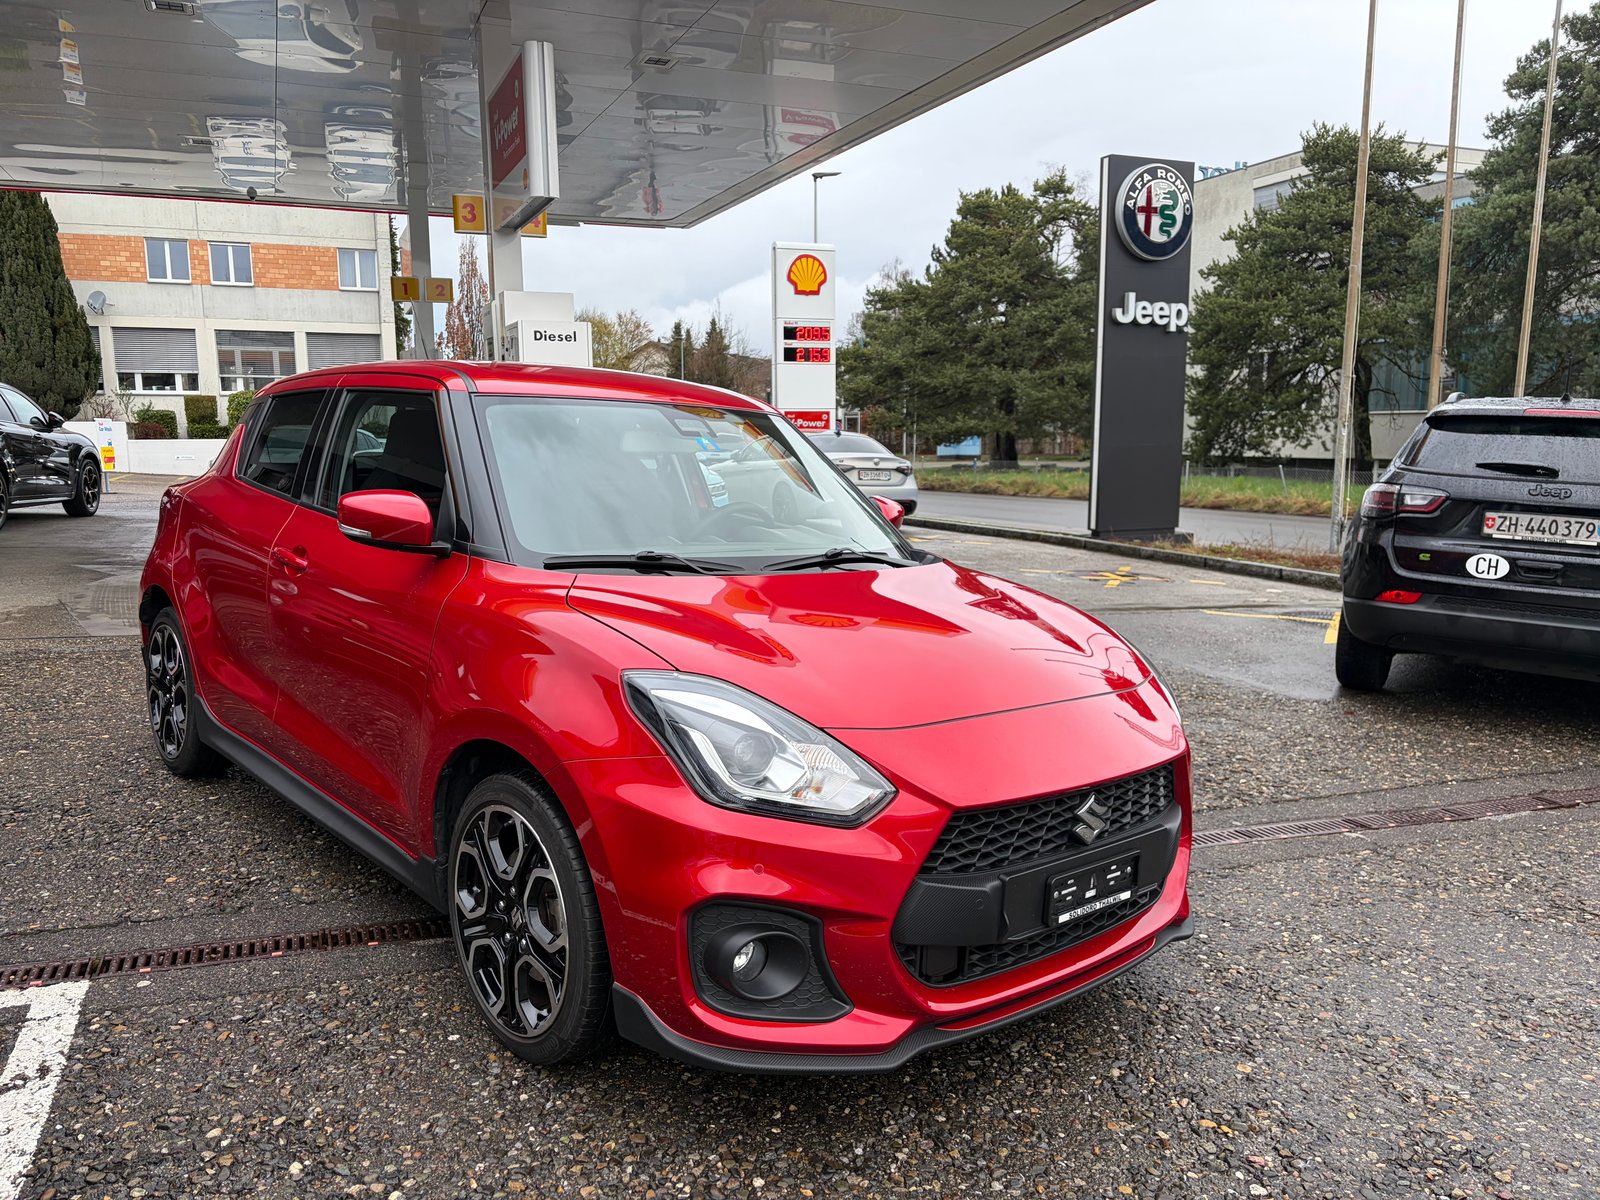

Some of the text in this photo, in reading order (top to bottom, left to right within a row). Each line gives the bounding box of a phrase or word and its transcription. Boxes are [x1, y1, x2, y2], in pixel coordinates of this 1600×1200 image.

[1126, 173, 1152, 210] ALFA
[1157, 168, 1192, 216] ROMEO
[461, 203, 477, 223] 3
[401, 282, 409, 296] 1
[435, 284, 446, 297] 2
[1112, 291, 1189, 332] Jeep
[533, 330, 577, 342] Diesel
[1528, 484, 1572, 500] Jeep
[1475, 557, 1500, 576] CH
[1069, 895, 1122, 919] SOLIDORO THALWIL
